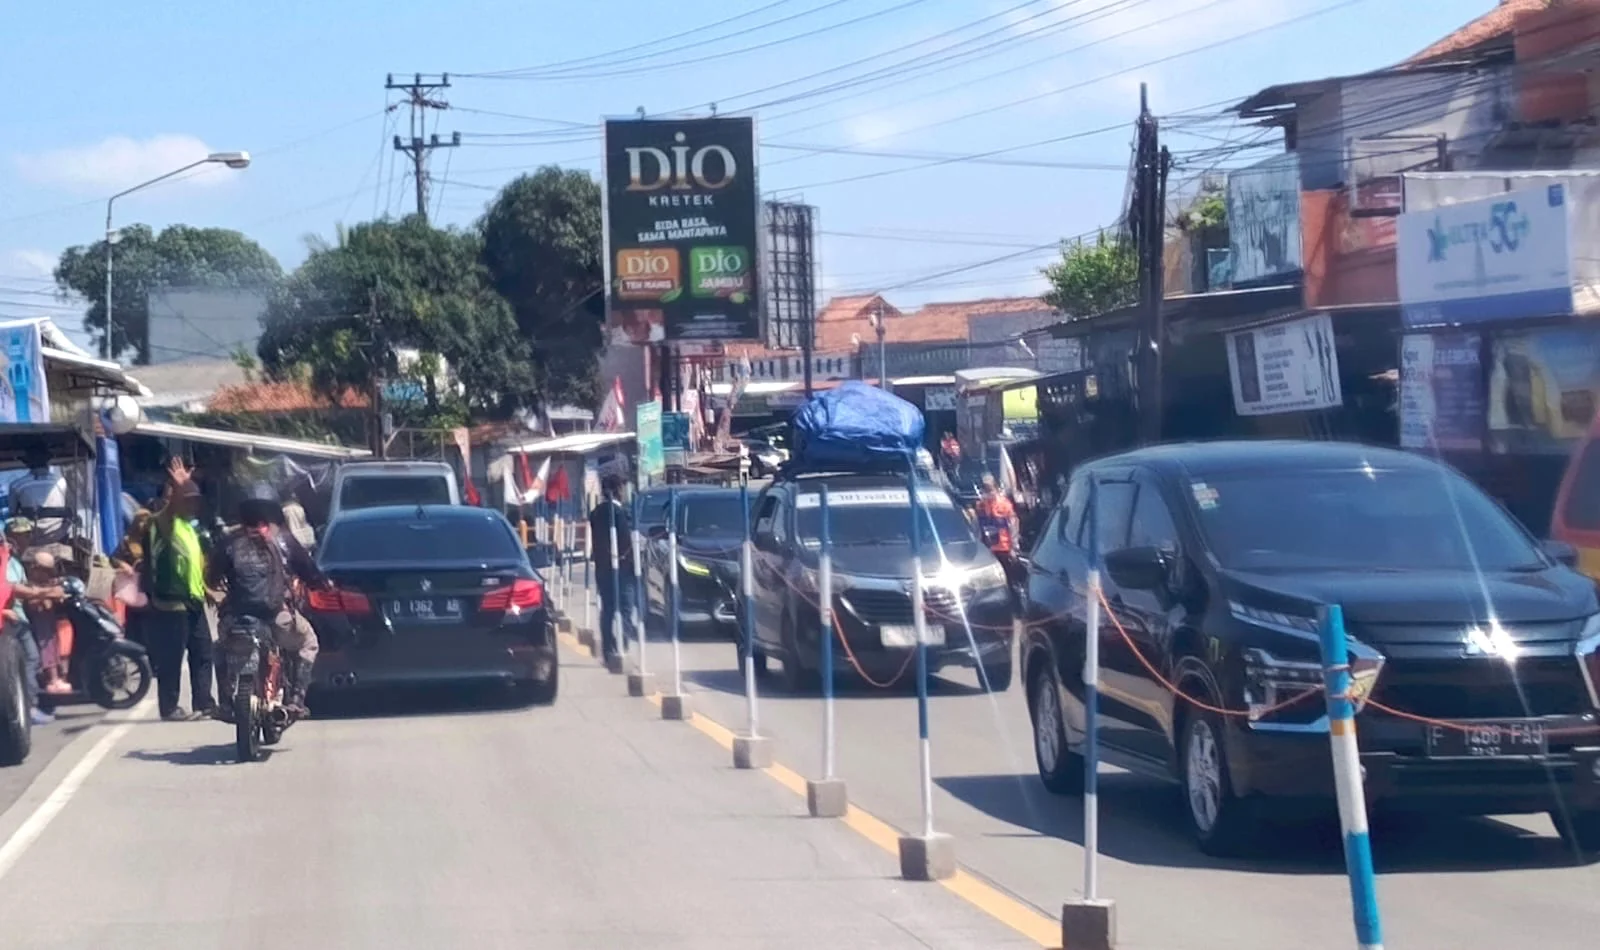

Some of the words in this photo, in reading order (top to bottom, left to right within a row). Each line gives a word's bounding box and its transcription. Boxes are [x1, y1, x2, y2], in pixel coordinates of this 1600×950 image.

[649, 194, 714, 206] KRETEK
[637, 230, 666, 243] SAMA
[667, 225, 728, 240] MANTAPNYA
[698, 276, 744, 289] JAMBU
[1431, 725, 1444, 746] F
